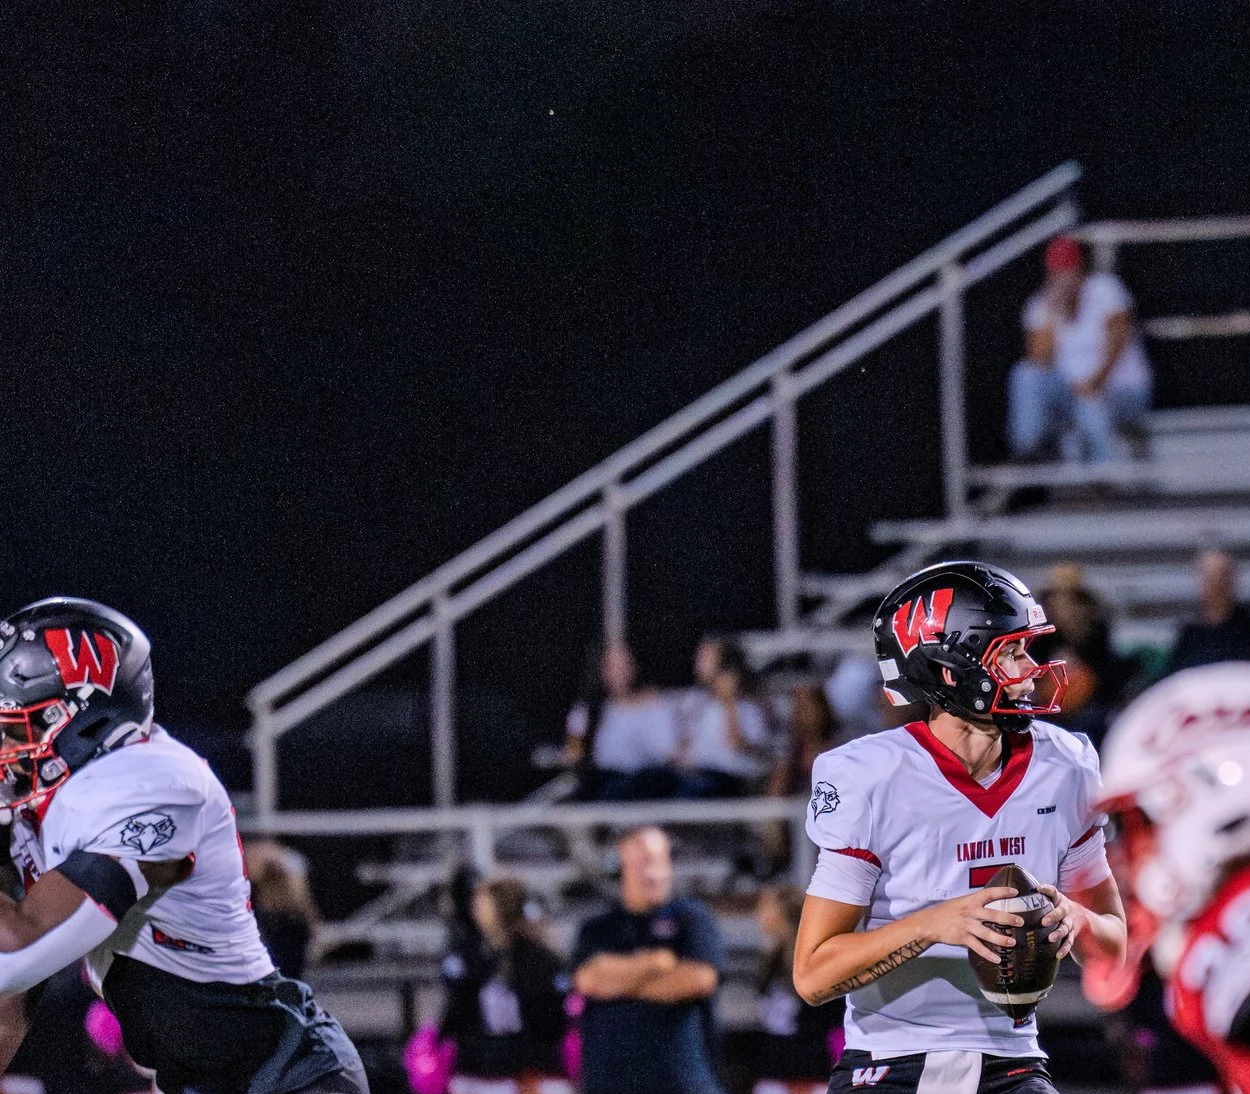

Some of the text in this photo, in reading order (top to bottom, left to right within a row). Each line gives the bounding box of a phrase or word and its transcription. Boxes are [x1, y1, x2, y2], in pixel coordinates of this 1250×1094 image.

[892, 588, 954, 658] W
[44, 627, 120, 697] W
[999, 836, 1026, 856] WEST
[852, 1065, 891, 1087] W
